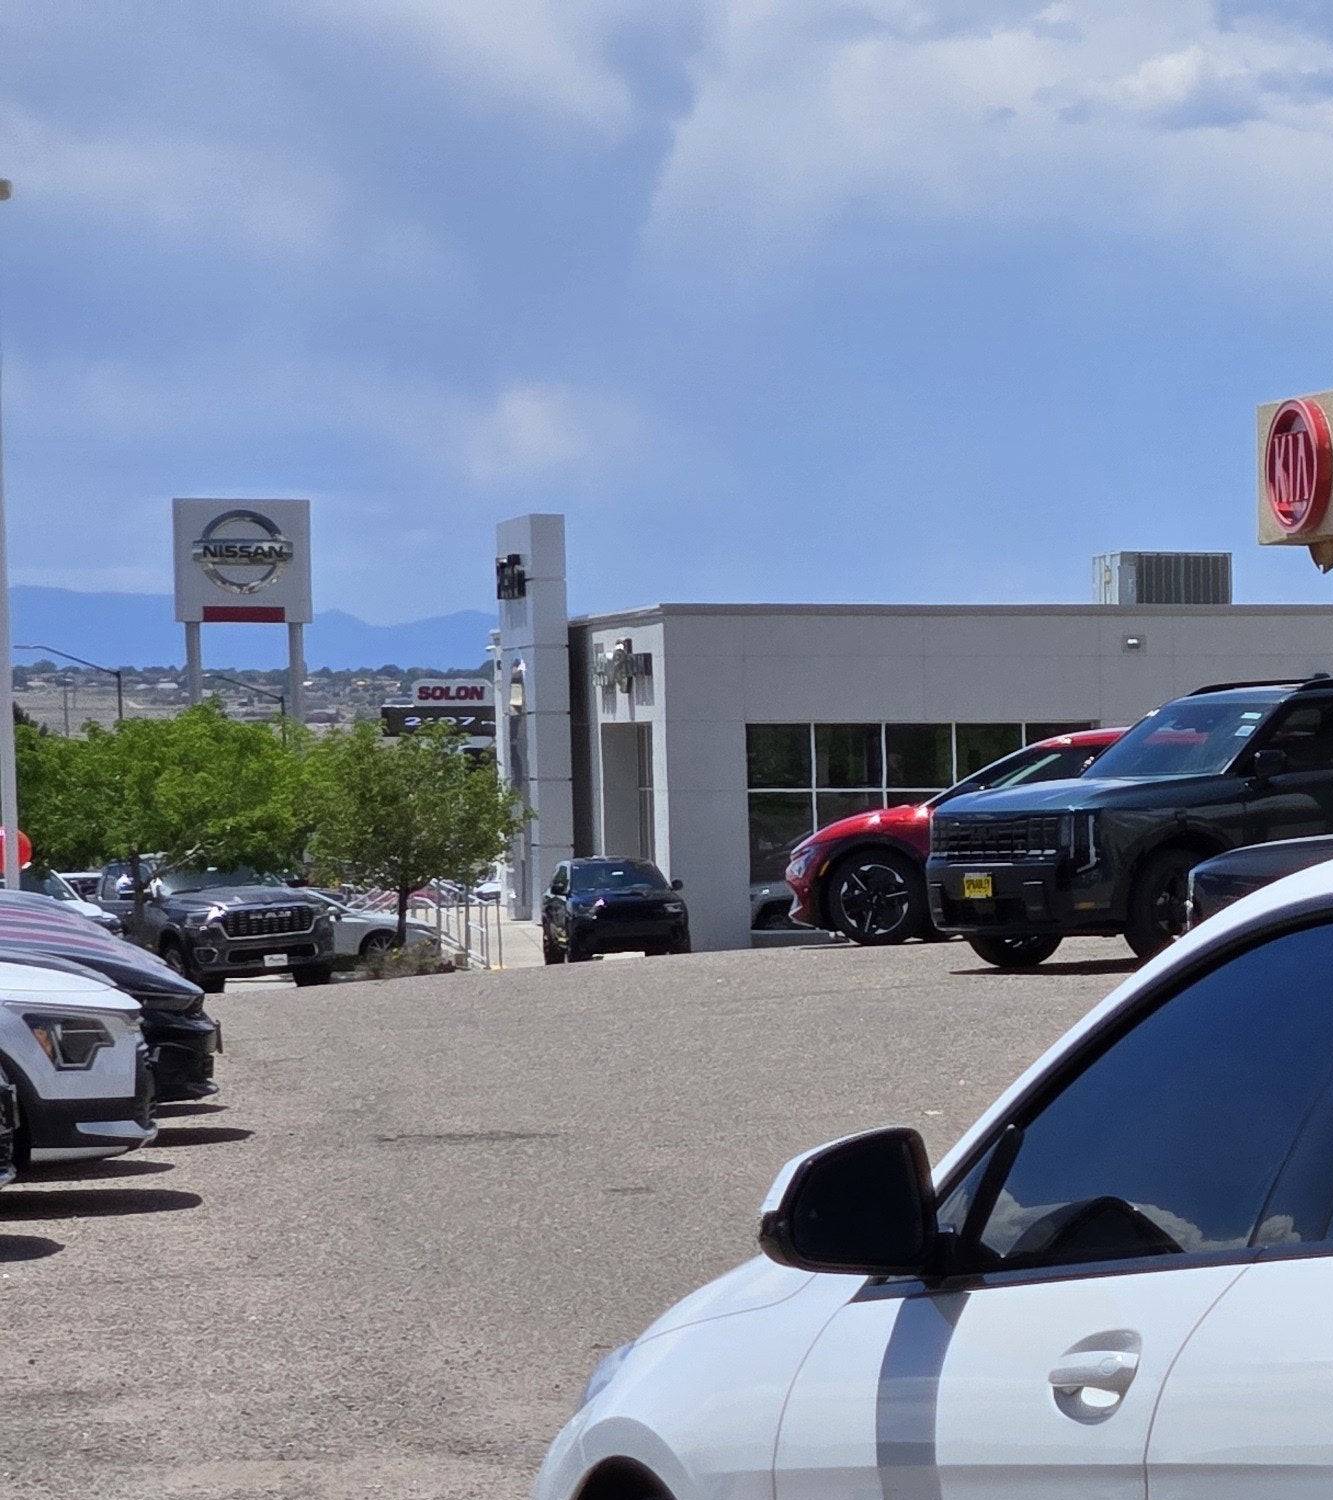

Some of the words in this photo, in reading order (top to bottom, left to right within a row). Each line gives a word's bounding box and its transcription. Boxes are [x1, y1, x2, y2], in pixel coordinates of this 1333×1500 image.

[1273, 431, 1309, 503] KIA
[202, 544, 284, 559] NISSAN
[418, 685, 486, 700] SOLON
